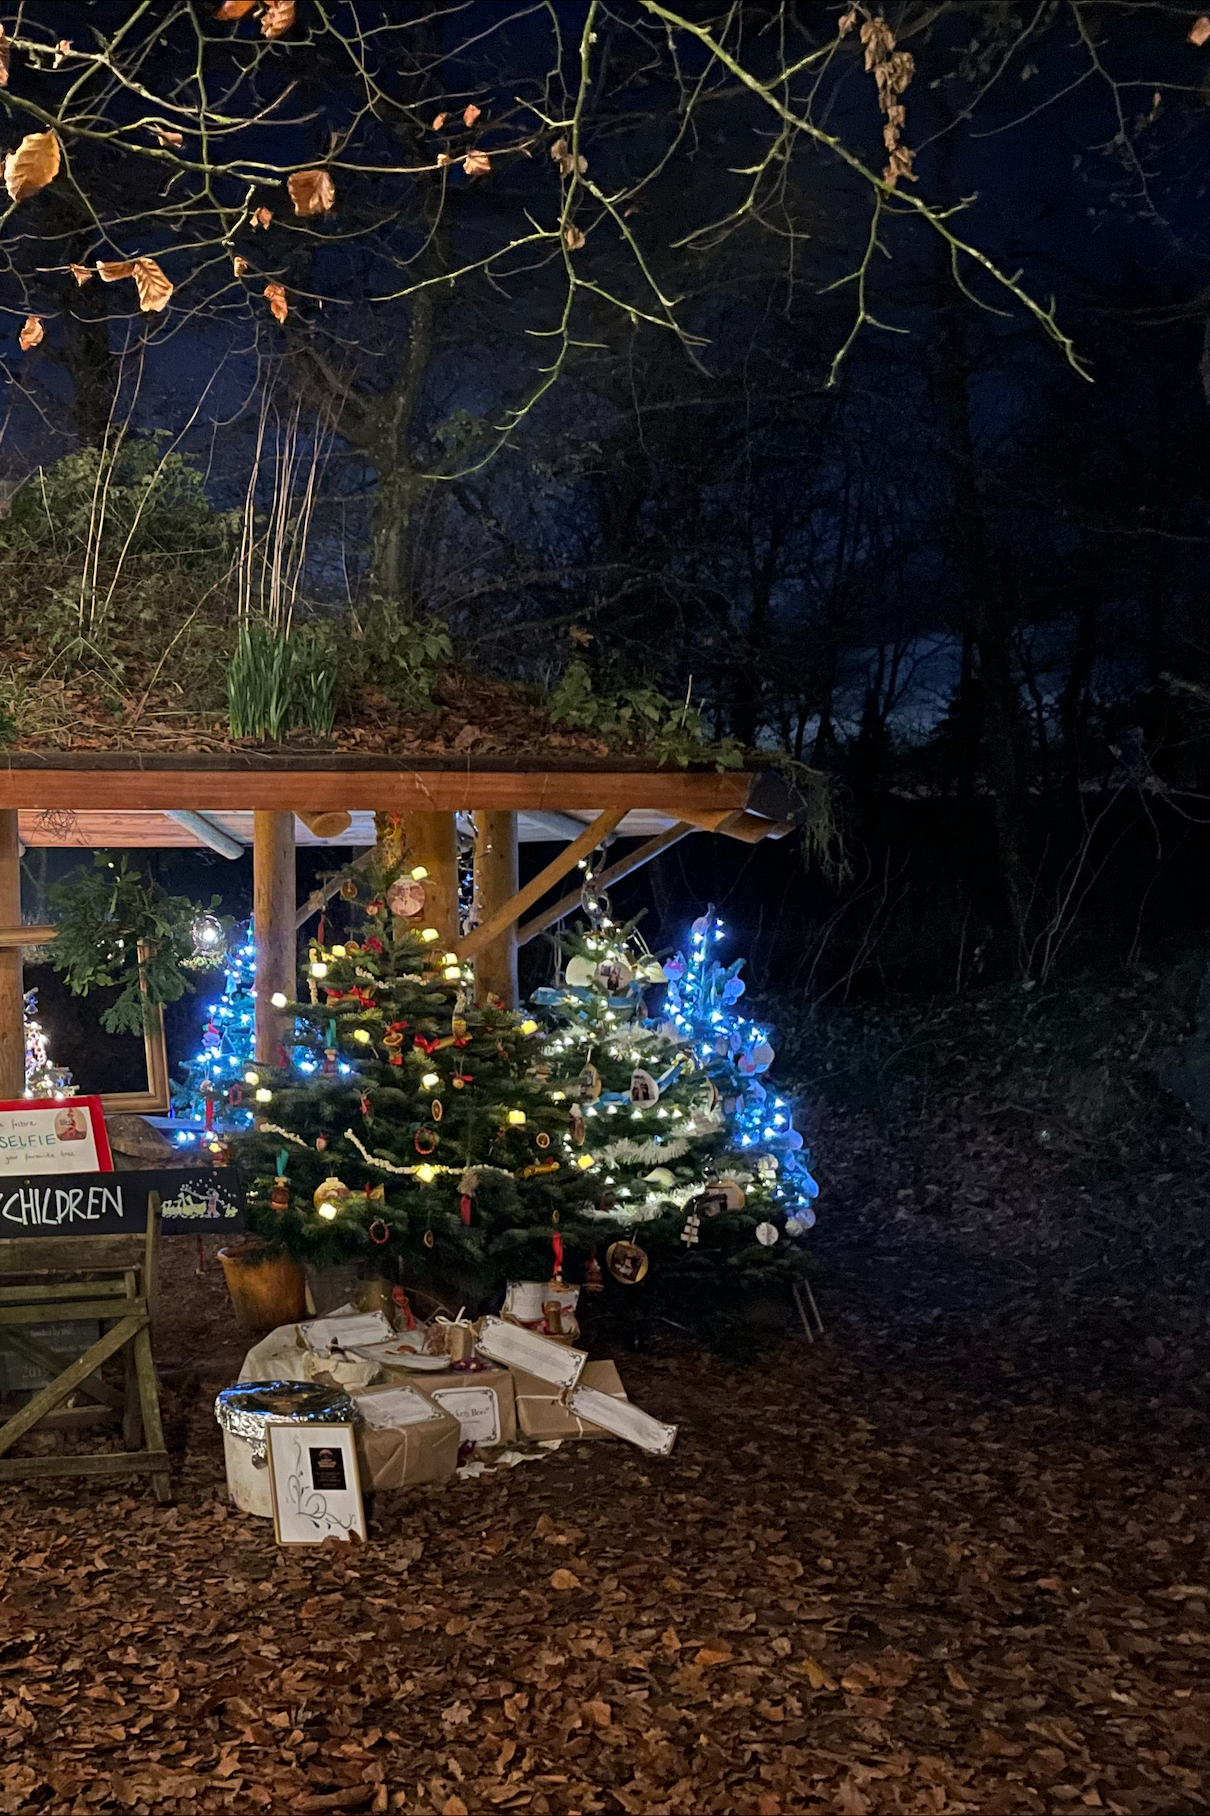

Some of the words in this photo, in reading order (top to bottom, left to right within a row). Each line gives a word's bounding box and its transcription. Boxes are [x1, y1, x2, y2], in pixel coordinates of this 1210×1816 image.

[5, 1154, 19, 1165] your
[60, 1150, 76, 1158] tree
[2, 1184, 124, 1226] CHILDREN
